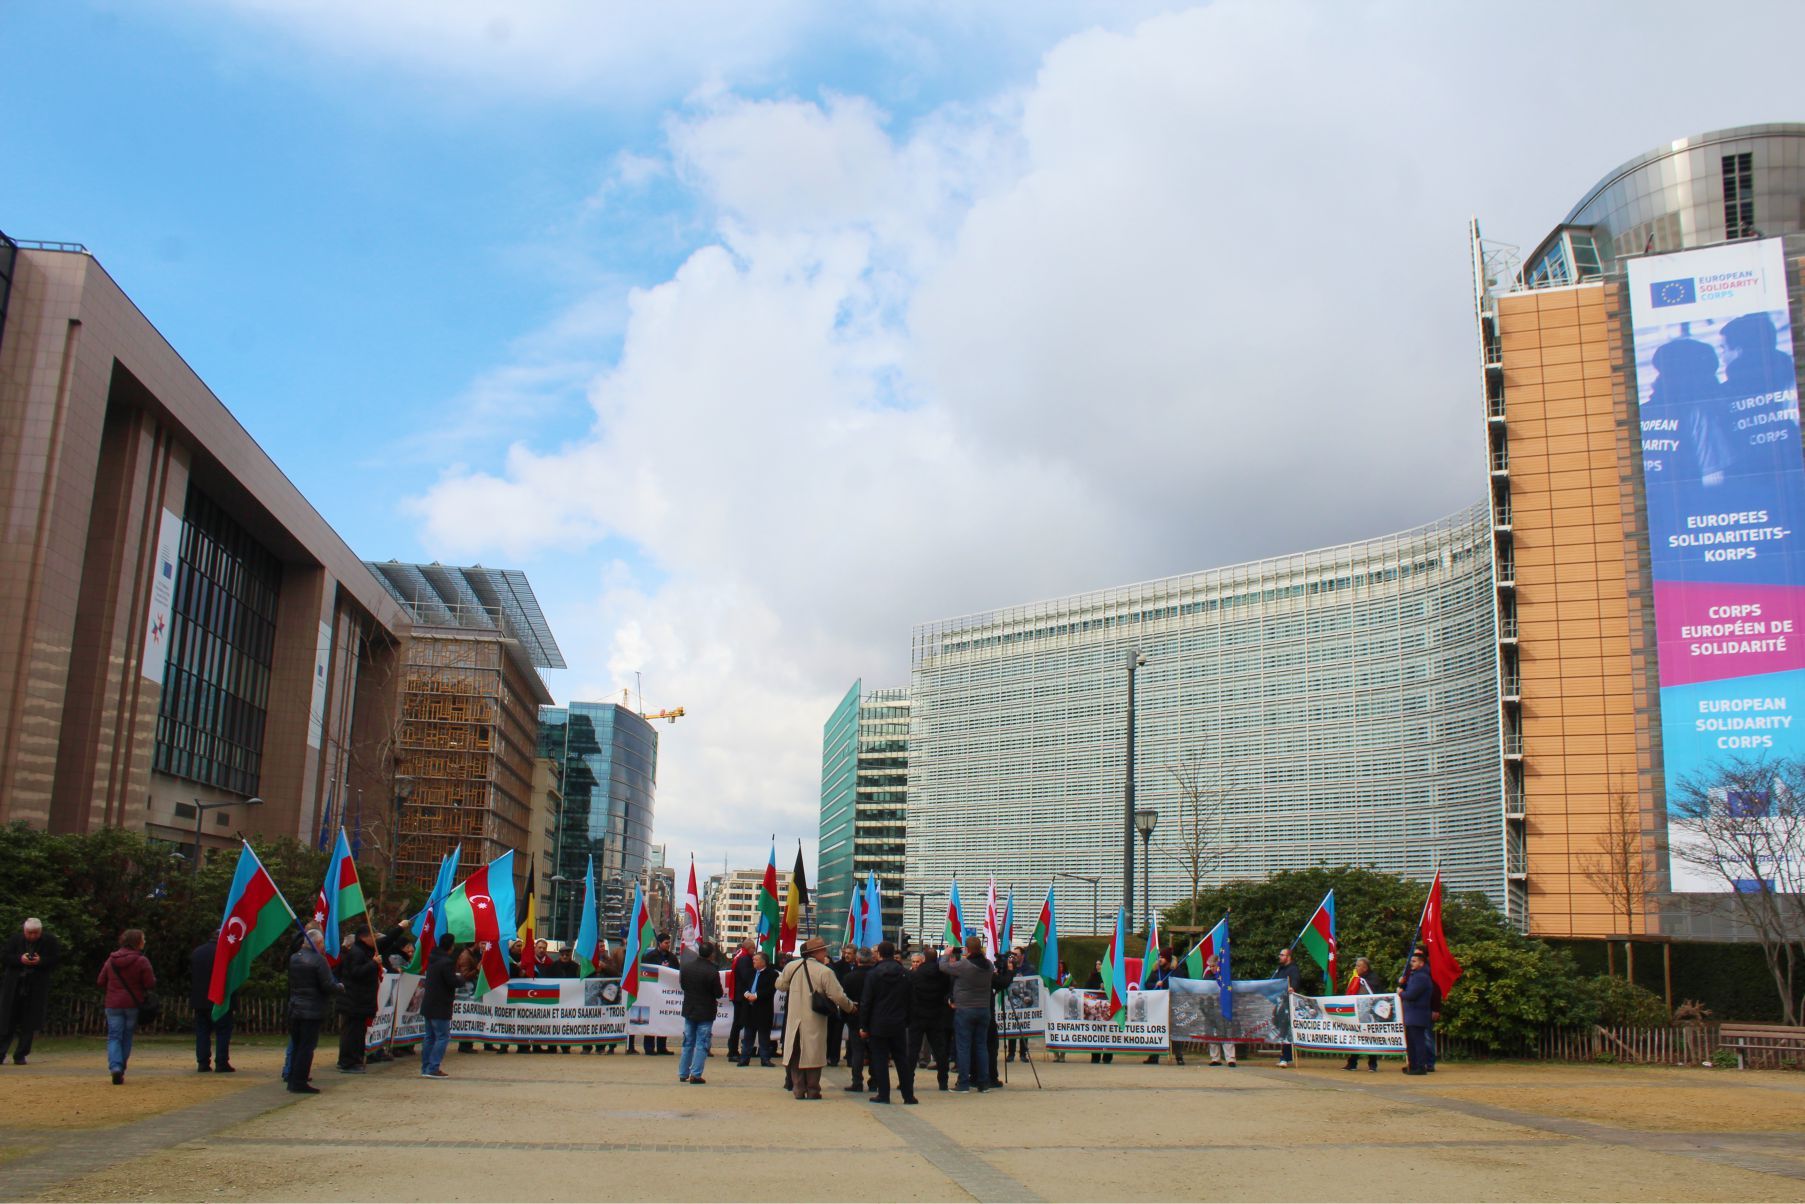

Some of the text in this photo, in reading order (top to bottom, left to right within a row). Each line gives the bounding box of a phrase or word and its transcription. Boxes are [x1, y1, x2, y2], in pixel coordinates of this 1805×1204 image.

[1699, 271, 1753, 285] EUROPEAN
[1700, 278, 1759, 293] SOLIDARITY
[1701, 290, 1735, 301] CORPS
[1687, 510, 1769, 528] EUROPEES
[1669, 527, 1791, 547] SOLIDARITEITS-
[1704, 547, 1757, 562] KORPS
[1709, 604, 1762, 618] CORPS
[1681, 620, 1794, 638] EUROPÉEN DE
[1690, 636, 1787, 655] SOLIDARITÉ
[1699, 697, 1787, 713] EUROPEAN
[1695, 715, 1792, 731] SOLIDARITY
[1717, 735, 1773, 749] CORPS
[517, 1008, 551, 1019] KOCHARIAN
[552, 1008, 560, 1018] ET
[560, 1008, 577, 1018] BAKO
[578, 1008, 602, 1018] SAAKIAN
[1024, 1012, 1030, 1020] DE
[490, 1022, 516, 1034] ACTEURS
[516, 1024, 552, 1035] PRINCIPAUX
[552, 1024, 560, 1035] DU
[591, 1024, 598, 1034] DE
[1057, 1022, 1090, 1032] ENFANTS
[1092, 1024, 1106, 1032] ONT
[1125, 1024, 1144, 1034] TUES
[1146, 1024, 1166, 1034] LORS
[1322, 1021, 1332, 1030] DE
[1367, 1023, 1404, 1034] PERPETREE
[1050, 1034, 1163, 1044] DE LA GENOCIDE DE KHODJALY
[1339, 1034, 1348, 1044] LE
[1388, 1036, 1403, 1046] 1992
